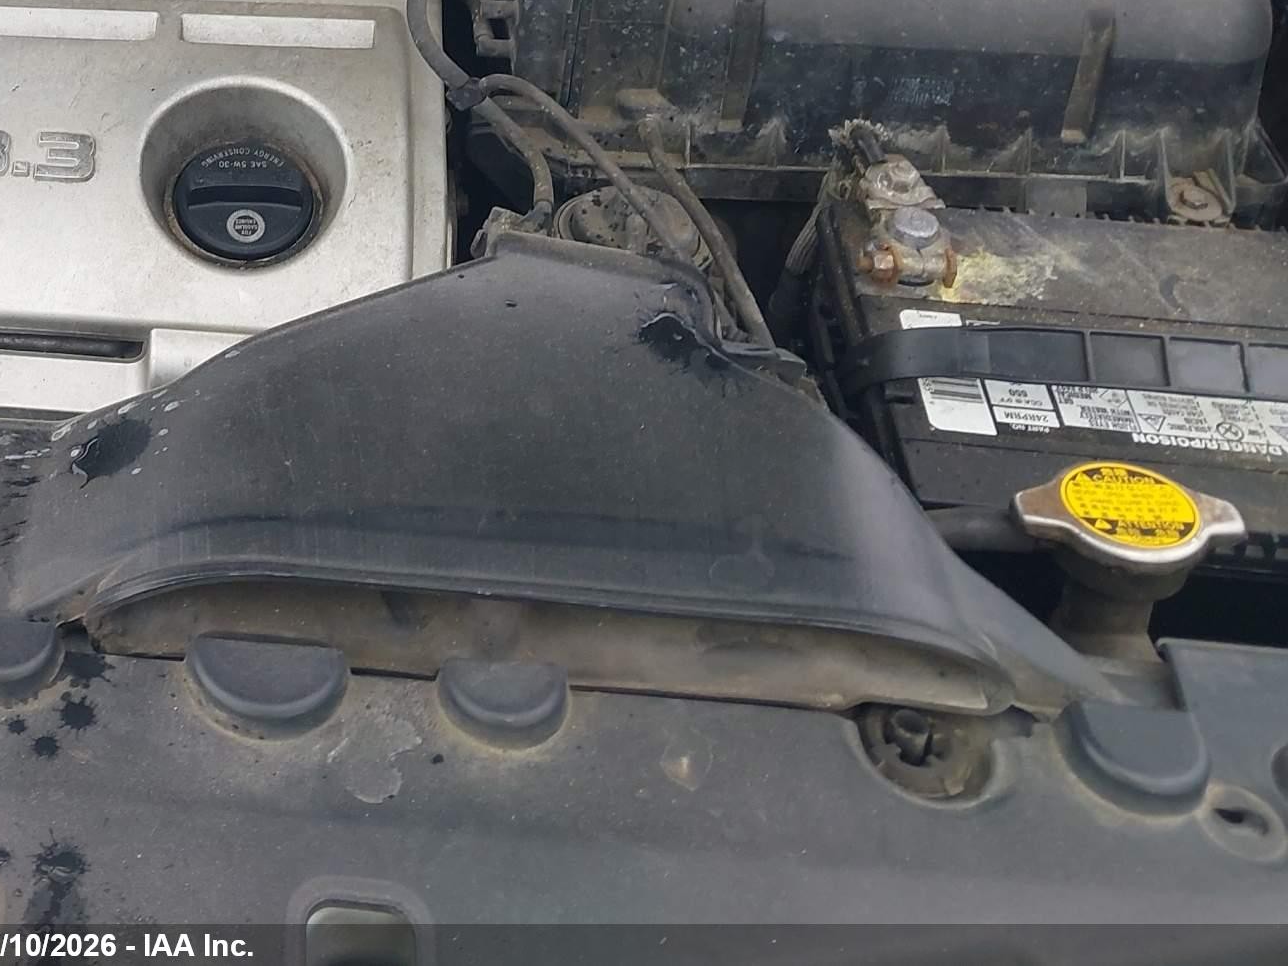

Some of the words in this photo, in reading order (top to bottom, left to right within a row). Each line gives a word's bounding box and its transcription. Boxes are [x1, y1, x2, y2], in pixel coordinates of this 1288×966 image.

[218, 160, 247, 169] 5W-30
[250, 160, 267, 169] SAE
[1027, 425, 1050, 433] PART
[1132, 433, 1282, 455] DANGER/POISON
